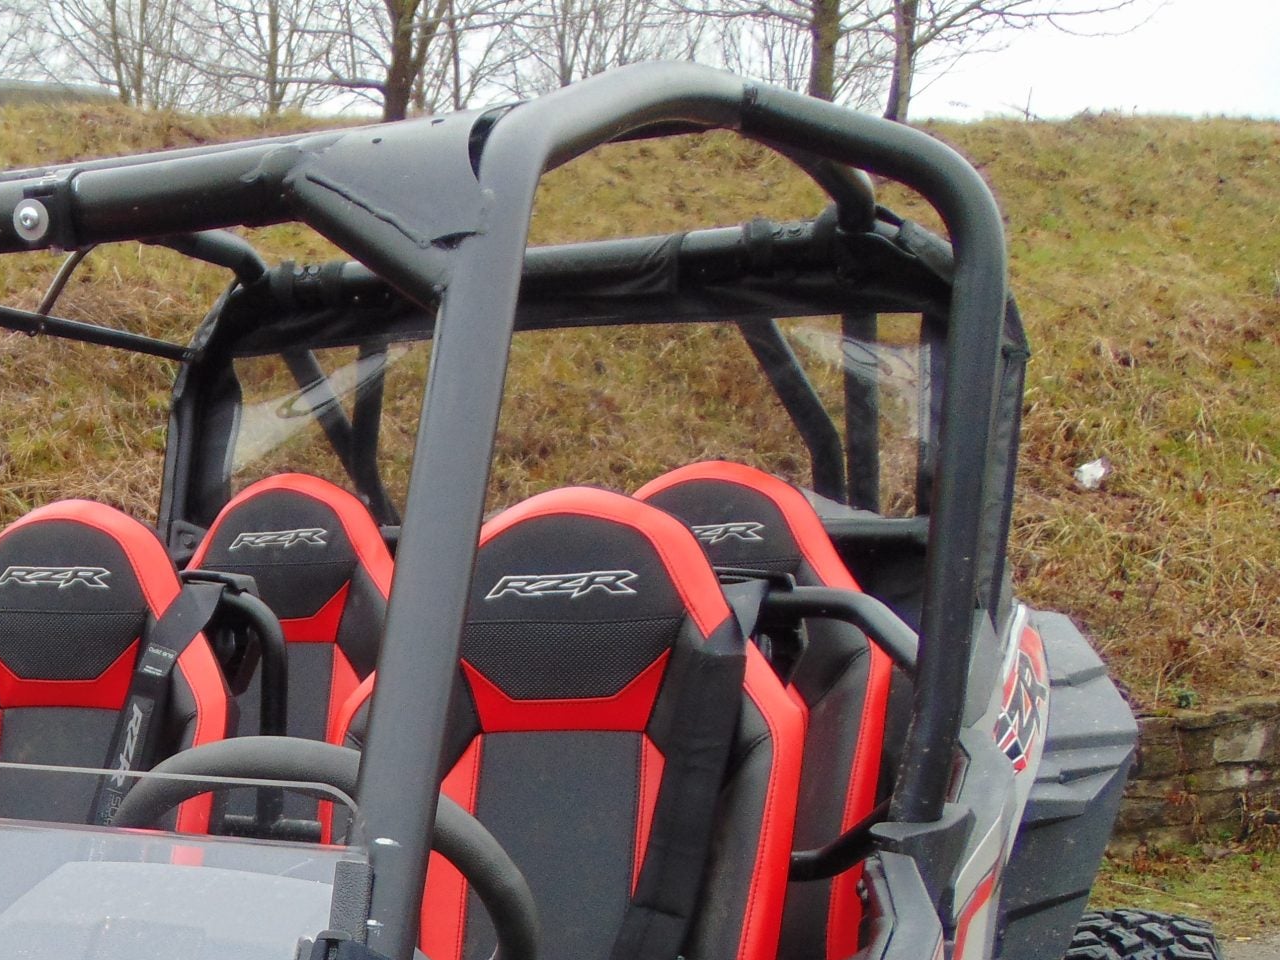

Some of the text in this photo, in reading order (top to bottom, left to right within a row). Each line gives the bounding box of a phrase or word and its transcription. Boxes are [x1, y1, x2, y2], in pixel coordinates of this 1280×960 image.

[228, 528, 328, 550] RZR
[691, 521, 765, 544] ZR
[484, 569, 639, 600] RZR
[111, 703, 143, 787] RZR
